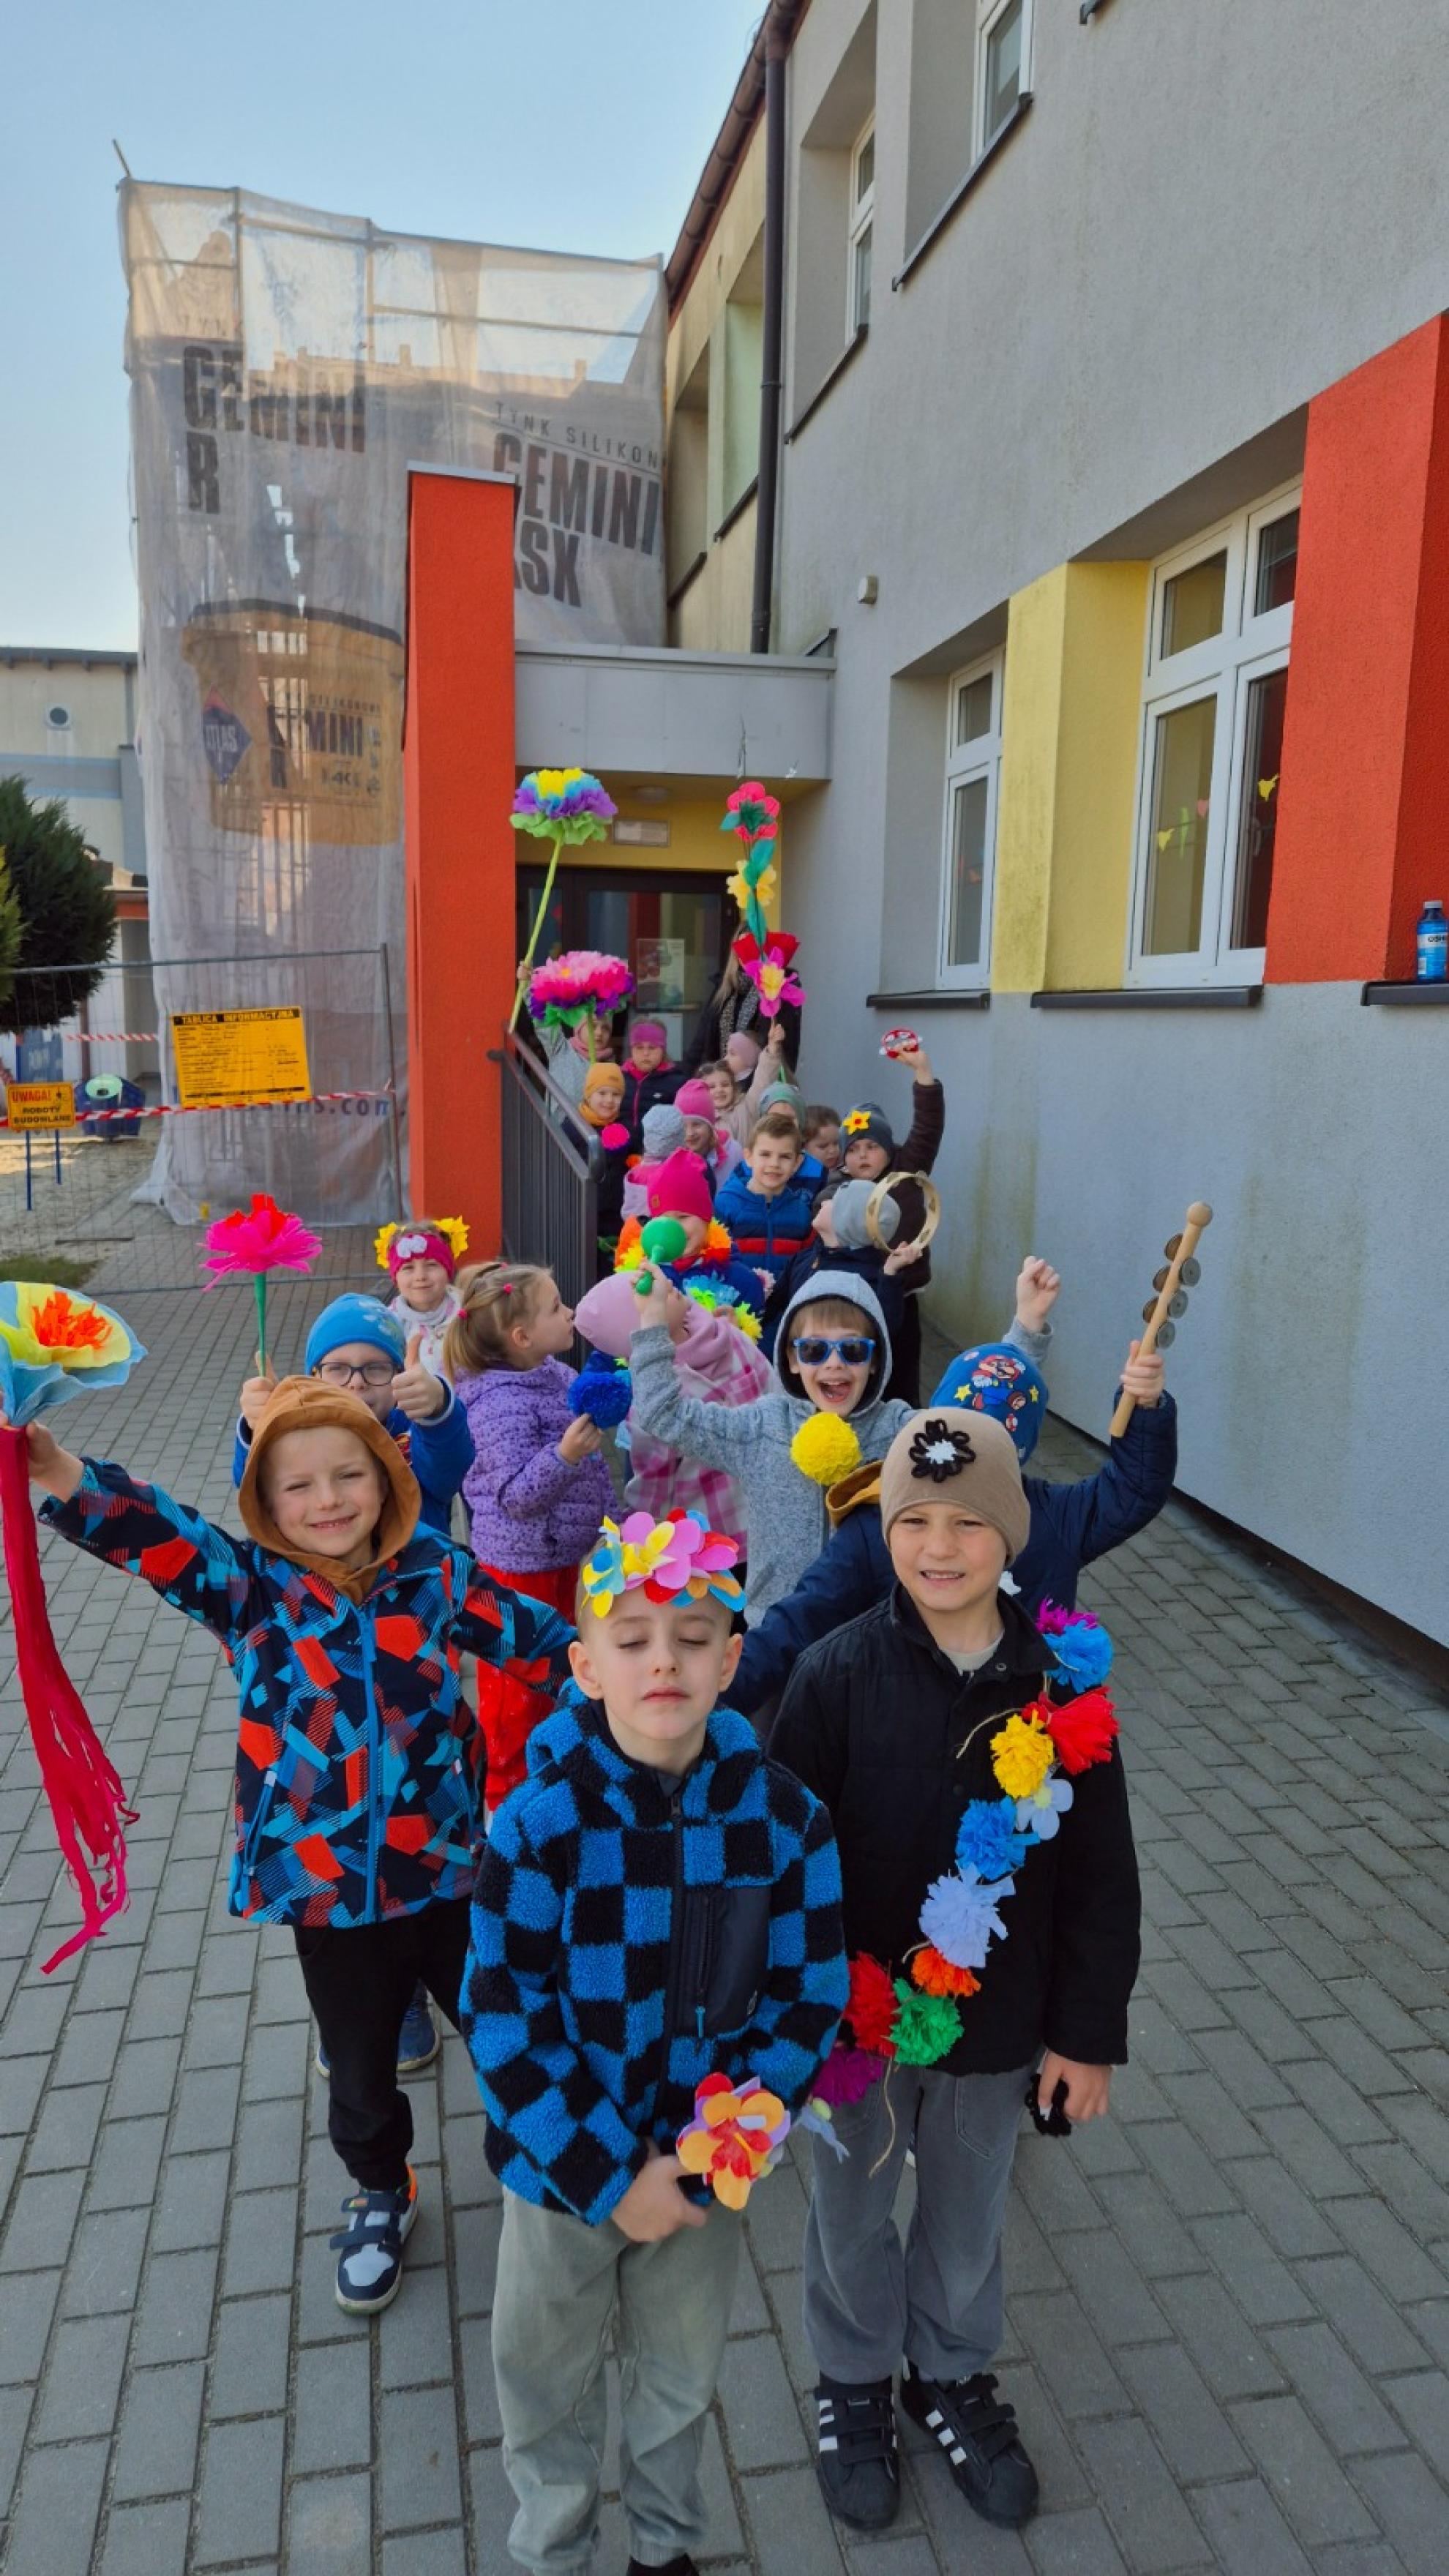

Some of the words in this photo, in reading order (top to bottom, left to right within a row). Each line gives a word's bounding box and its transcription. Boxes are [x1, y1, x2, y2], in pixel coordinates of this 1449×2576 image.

[186, 430, 220, 514] R
[514, 519, 582, 608] SK
[12, 1089, 52, 1103] UWAGA!
[22, 1105, 61, 1115] ROBOTY
